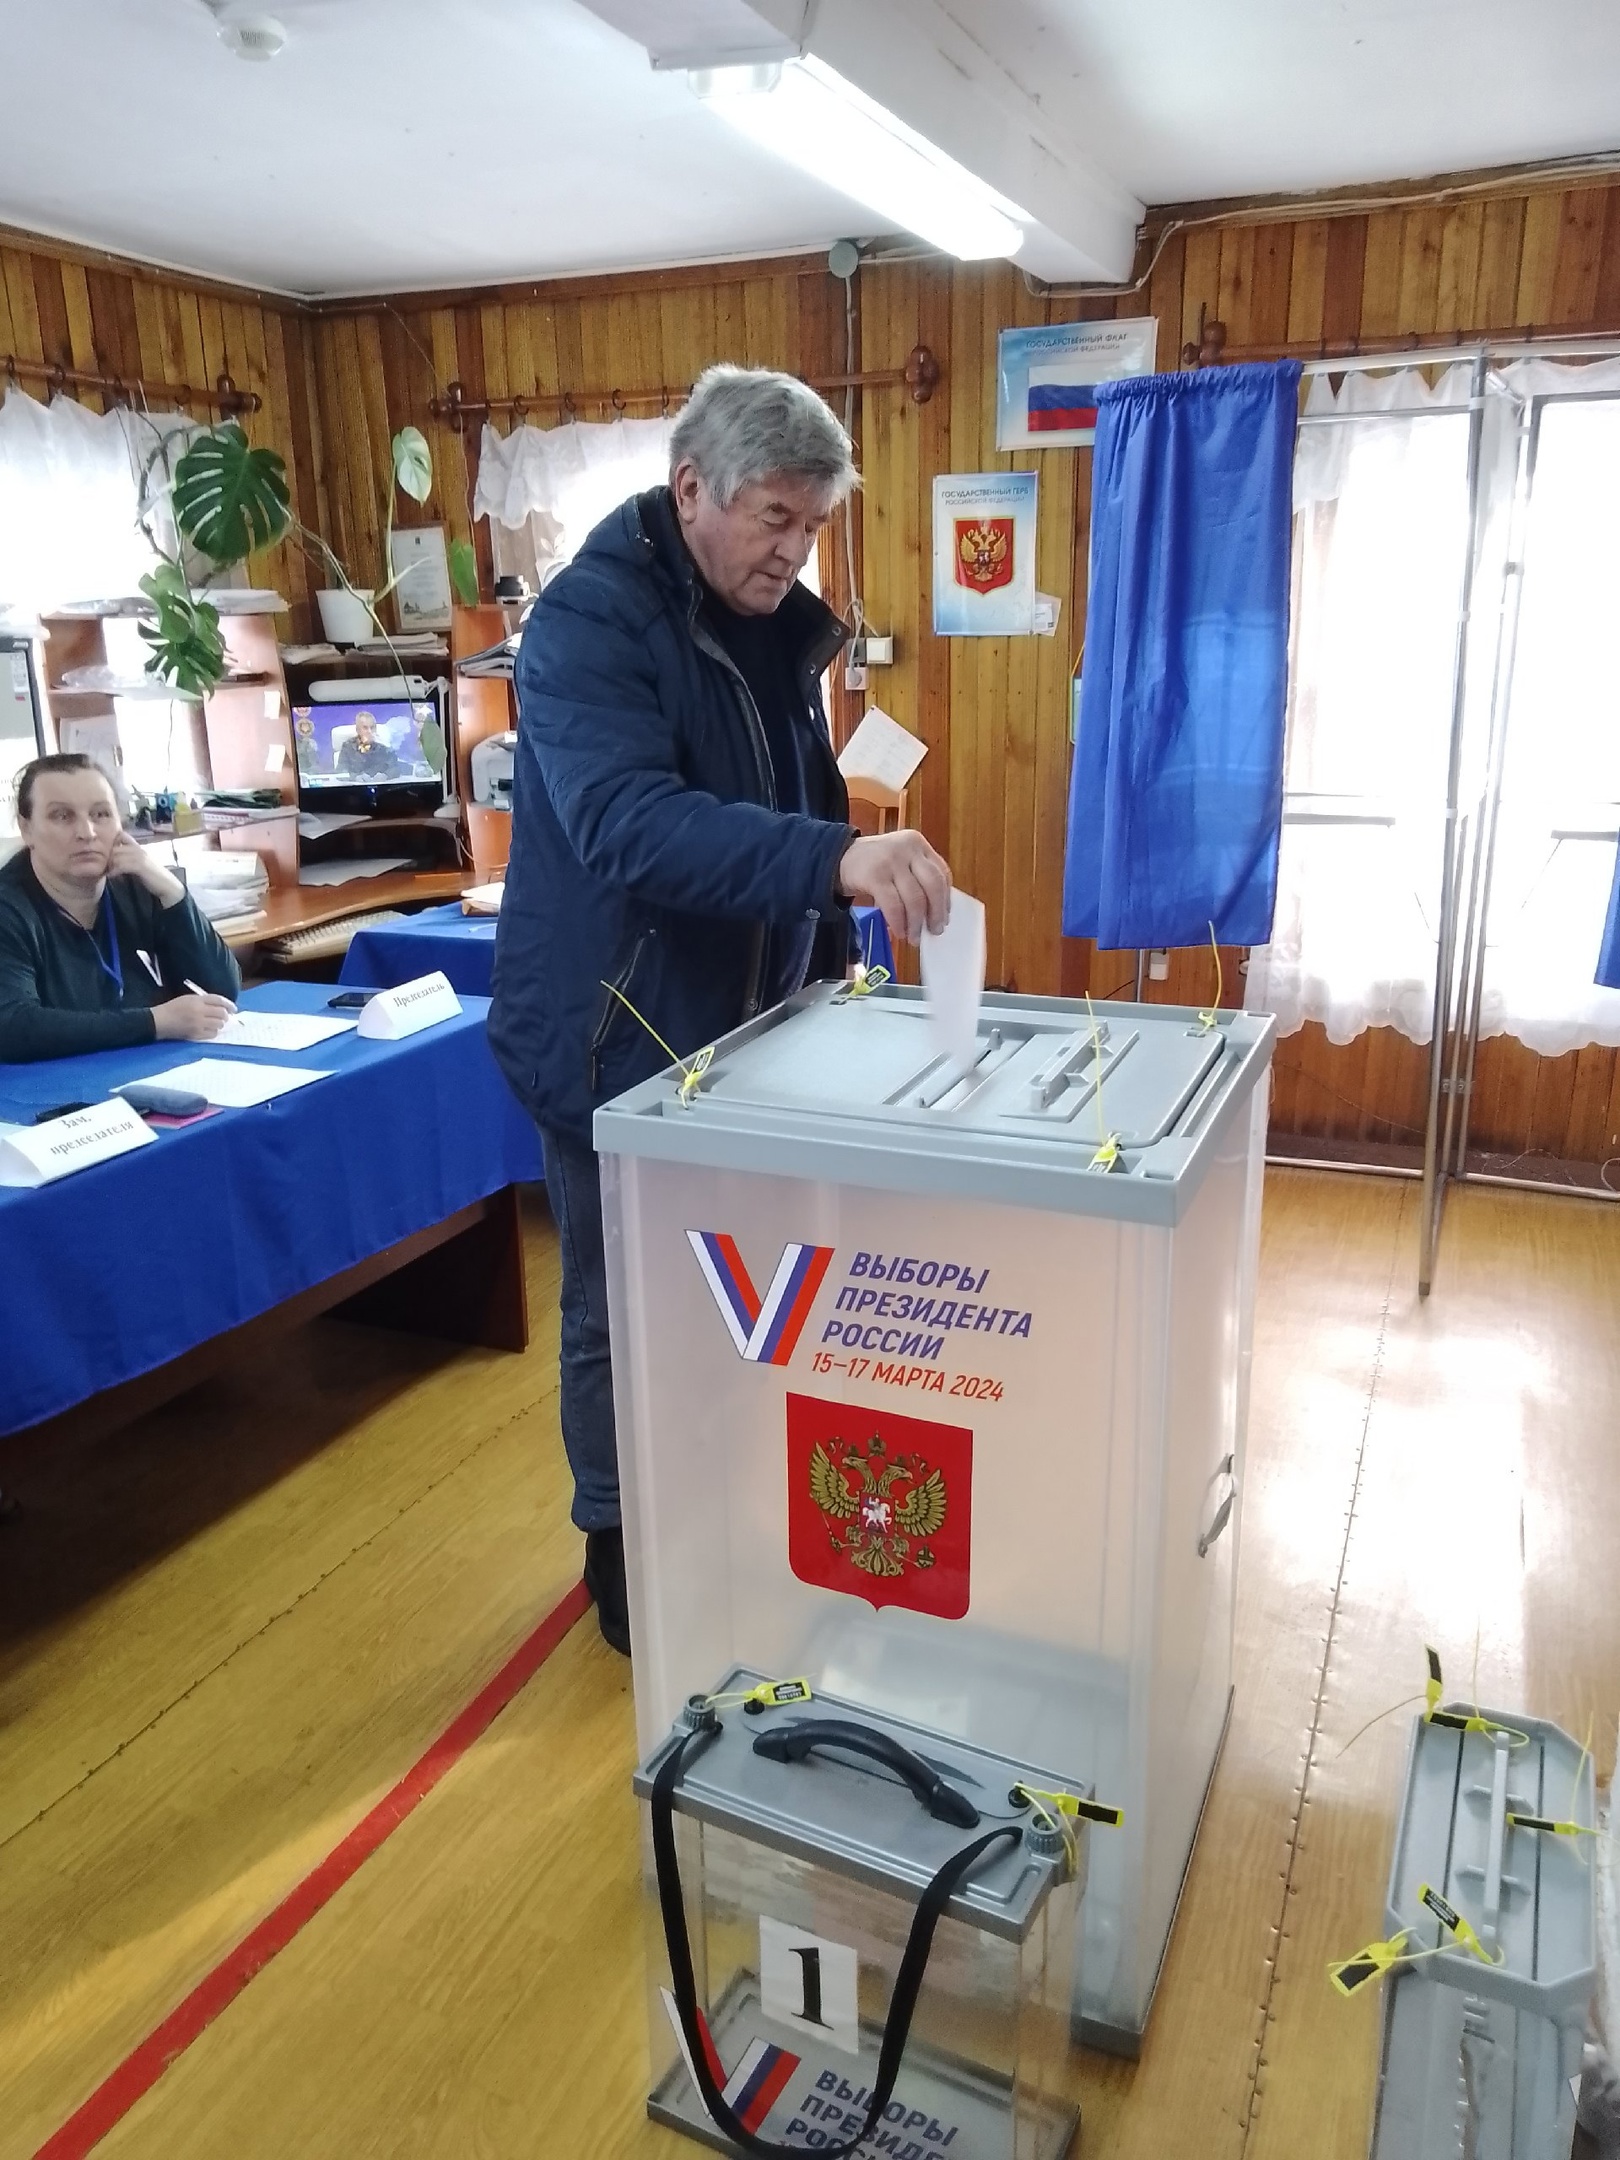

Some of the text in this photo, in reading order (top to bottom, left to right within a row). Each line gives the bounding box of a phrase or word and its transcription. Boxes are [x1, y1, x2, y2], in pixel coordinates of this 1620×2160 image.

[1026, 333, 1128, 348] ГОСУДАРСТВЕННЫЙ ФЛАГ
[941, 486, 1029, 499] ГОСУДАРСТВЕННЫЙ ГЕРБ
[392, 983, 446, 1008] Председатель
[50, 1120, 135, 1156] председателя
[849, 1251, 991, 1294] ВЫБОРЫ
[835, 1286, 1034, 1338] ПРЕЗИДЕНТА
[821, 1320, 946, 1360] РОССИИ
[871, 1361, 946, 1394] МАРТА
[948, 1373, 1005, 1403] 2024
[787, 1946, 836, 2031] 1
